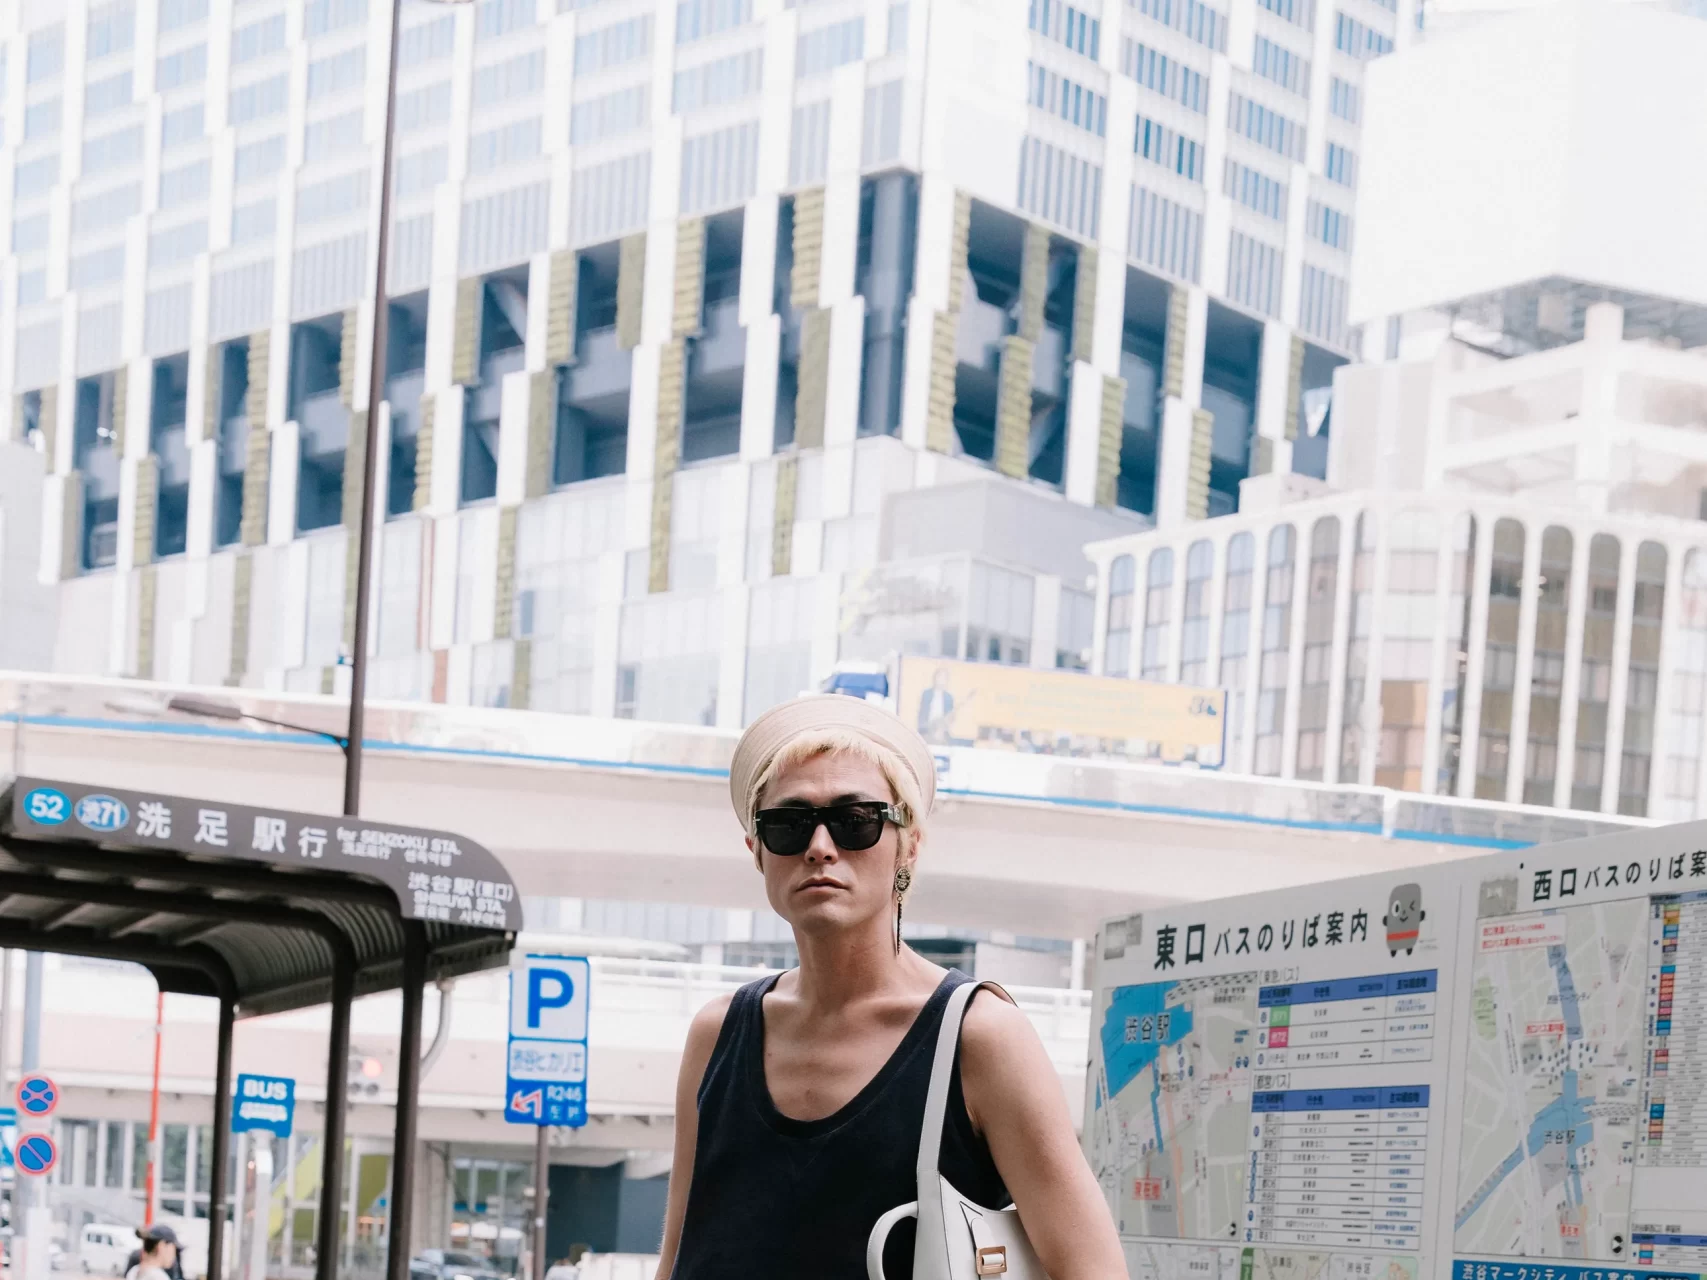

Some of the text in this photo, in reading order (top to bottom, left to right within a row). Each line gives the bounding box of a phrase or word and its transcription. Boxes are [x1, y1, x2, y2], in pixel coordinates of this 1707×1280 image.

[31, 793, 64, 821] 52
[136, 800, 328, 859] 洗足駅行
[360, 829, 429, 849] SENZOKU
[431, 838, 462, 856] STA.
[527, 967, 574, 1028] P
[1126, 1014, 1171, 1041] 渋谷駅
[243, 1079, 287, 1100] BUS
